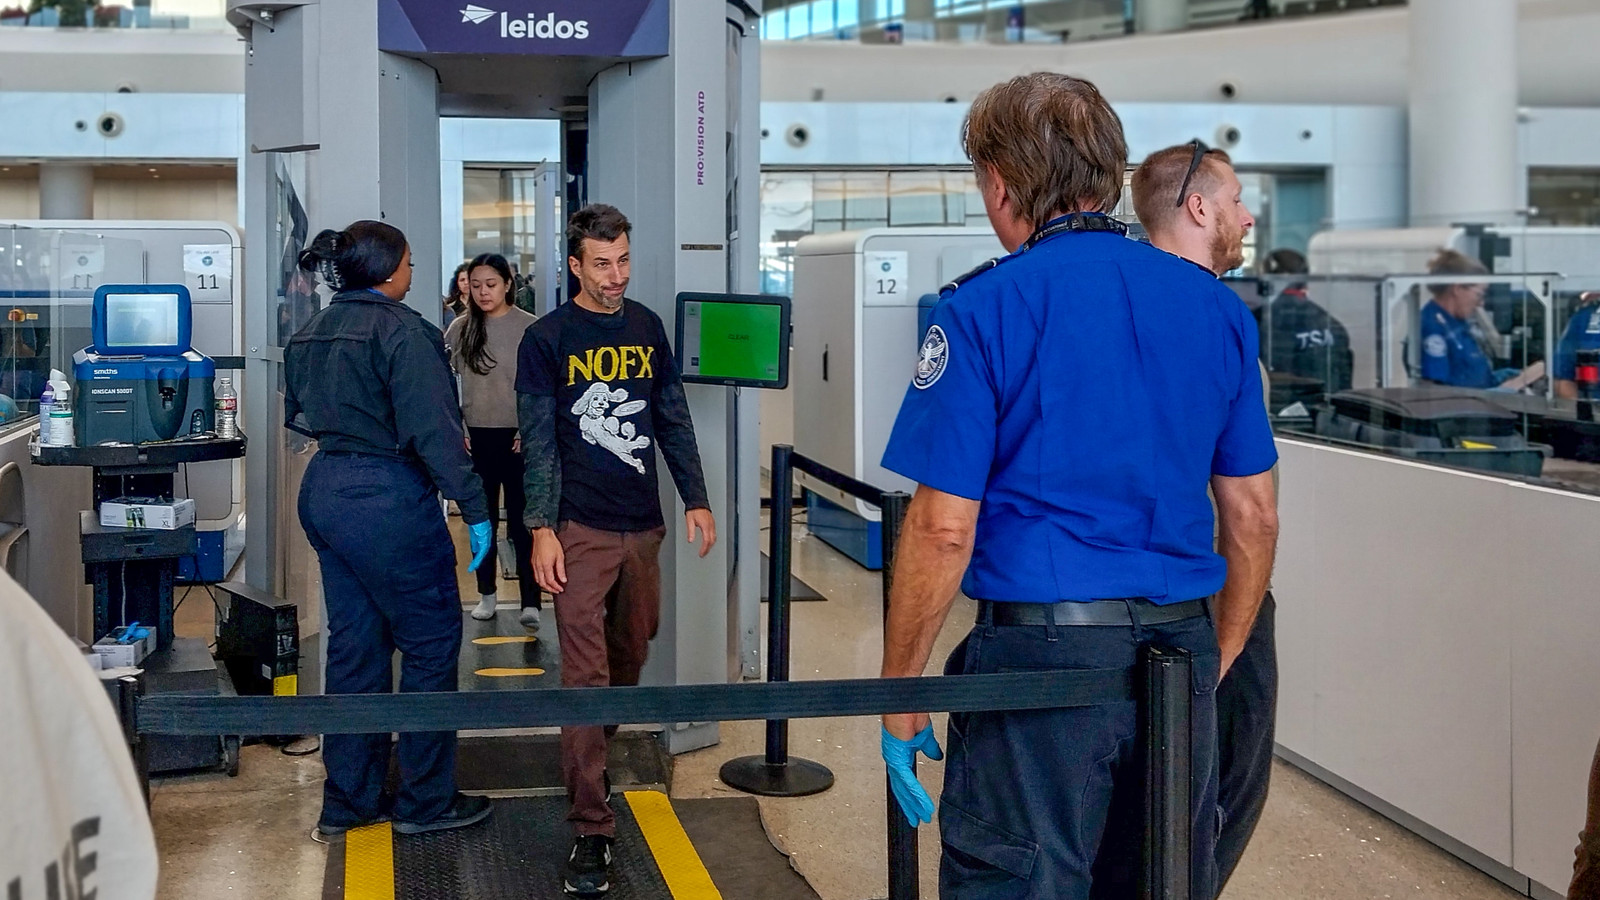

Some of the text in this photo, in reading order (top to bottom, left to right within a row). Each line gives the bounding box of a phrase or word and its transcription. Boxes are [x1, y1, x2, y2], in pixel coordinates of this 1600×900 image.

[500, 11, 590, 40] leidos
[697, 91, 705, 114] ATD
[197, 273, 220, 290] 11
[876, 278, 897, 295] 12
[566, 346, 655, 387] NOFX
[162, 520, 171, 528] XL
